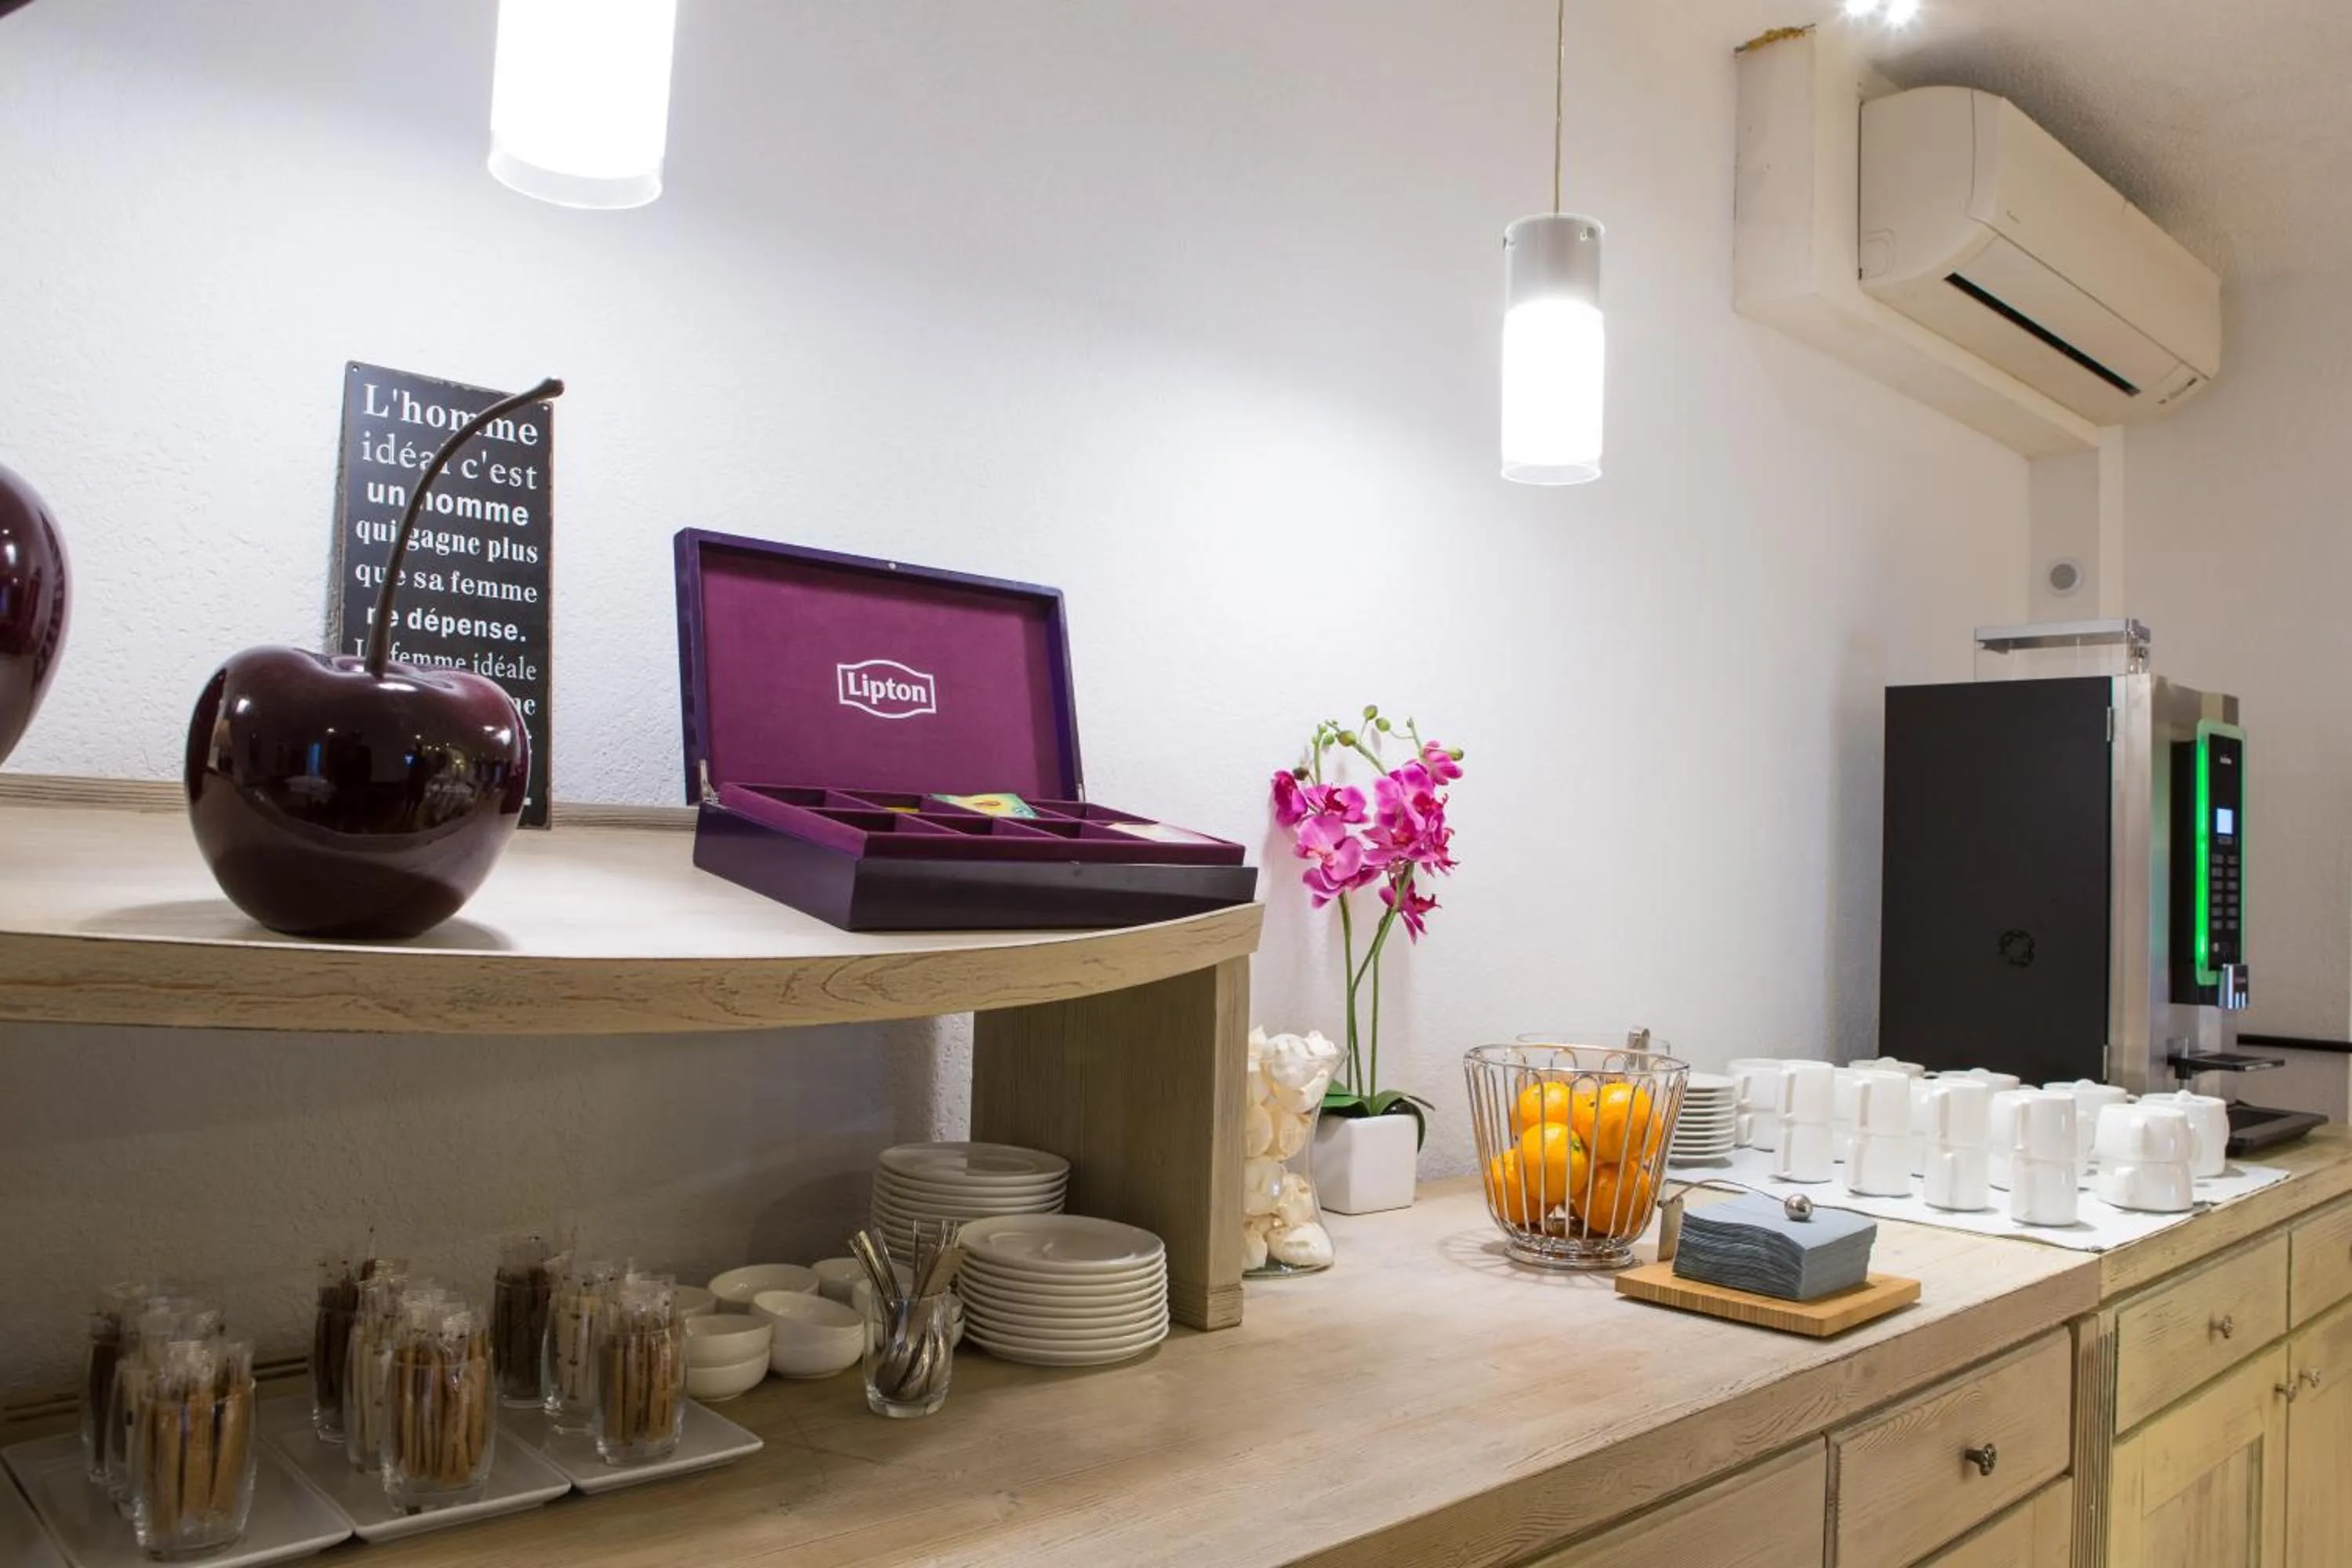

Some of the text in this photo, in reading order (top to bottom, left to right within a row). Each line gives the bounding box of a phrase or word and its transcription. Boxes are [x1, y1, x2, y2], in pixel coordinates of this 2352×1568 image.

[460, 450, 537, 490] c'est
[367, 482, 405, 506] un
[355, 518, 539, 564] qui gagne plus
[413, 571, 445, 591] sa
[451, 570, 538, 603] femme
[407, 608, 527, 642] dépense.
[473, 652, 538, 681] idéale
[847, 671, 927, 705] Lipton
